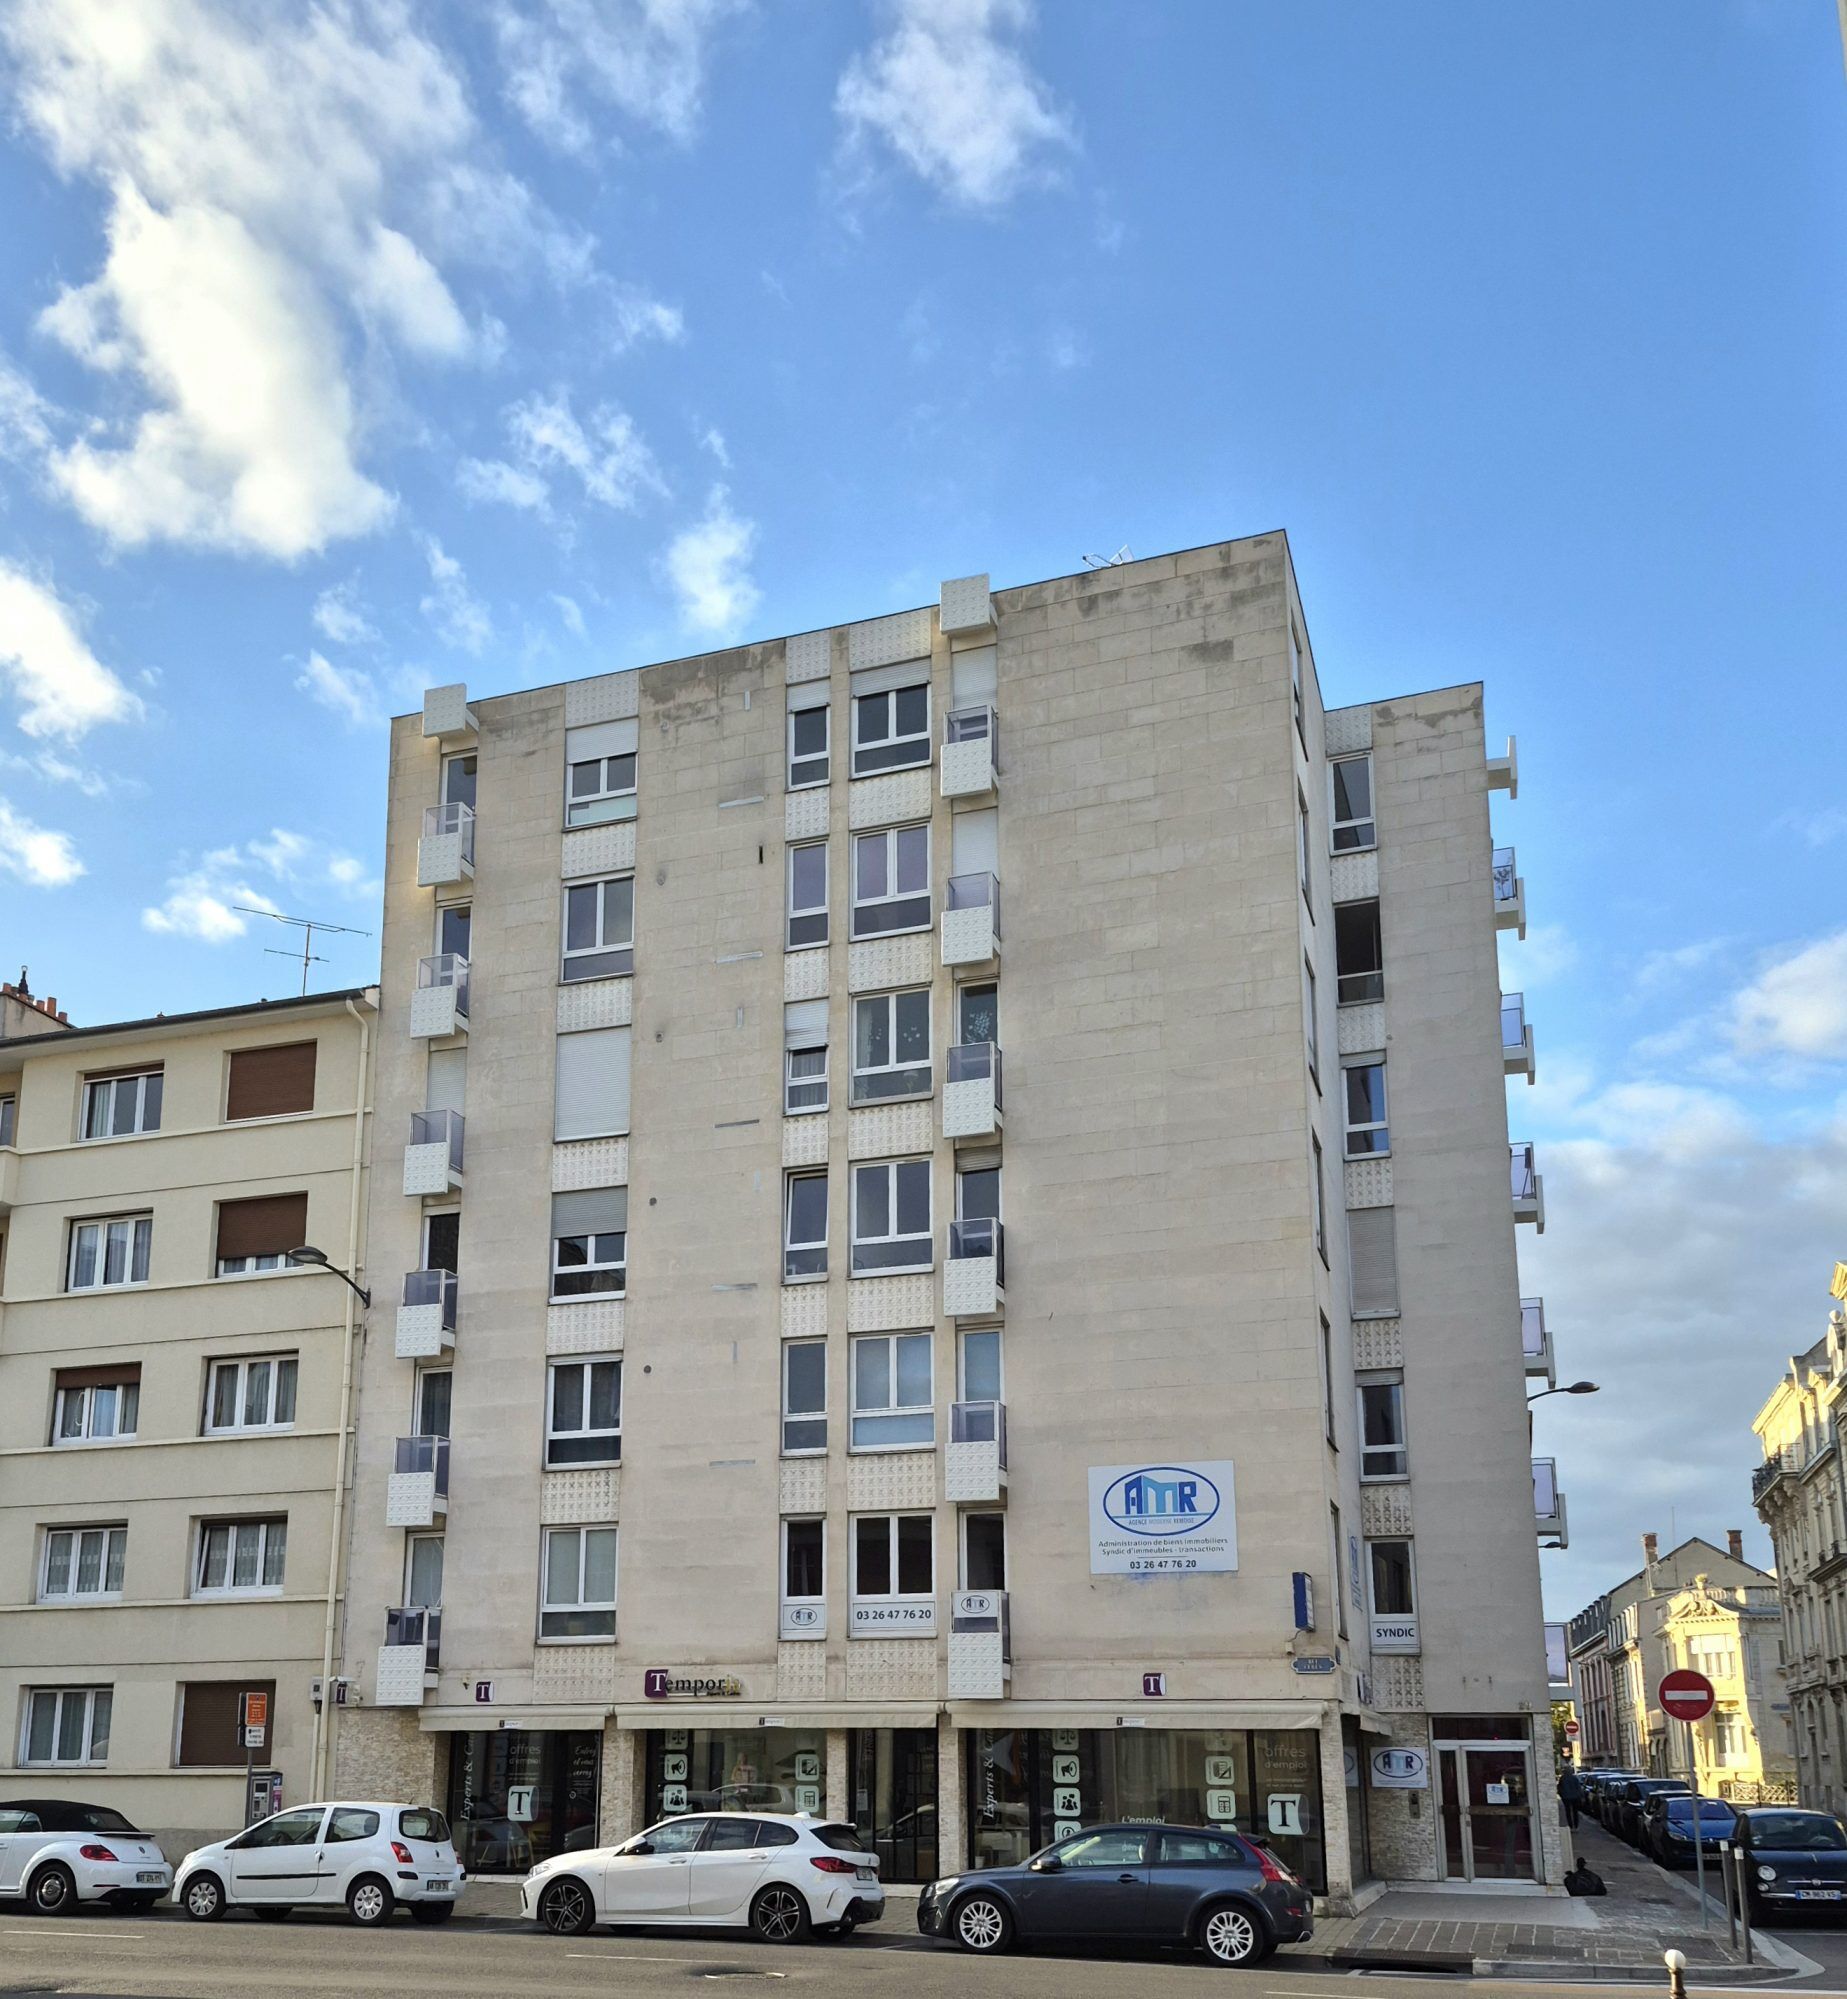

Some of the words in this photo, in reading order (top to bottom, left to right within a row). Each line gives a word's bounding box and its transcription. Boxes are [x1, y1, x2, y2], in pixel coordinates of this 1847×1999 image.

[1124, 1475, 1197, 1515] AMR
[1098, 1540, 1152, 1548] Administration
[1163, 1538, 1183, 1546] biens
[1184, 1537, 1228, 1545] immobiliers
[1102, 1547, 1125, 1556] Syndic
[1126, 1546, 1173, 1555] d'immeubles
[1179, 1545, 1225, 1553] transactions
[1129, 1561, 1141, 1570] 03
[1143, 1560, 1155, 1569] 26
[1157, 1560, 1168, 1568] 47
[1171, 1559, 1183, 1568] 76
[1185, 1559, 1197, 1568] 20
[856, 1609, 870, 1620] 03
[872, 1609, 885, 1620] 26
[887, 1609, 900, 1620] 47
[903, 1608, 916, 1620] 76
[918, 1608, 932, 1619] 20
[1376, 1627, 1415, 1638] SYNDIC
[1144, 1676, 1159, 1693] T
[477, 1684, 489, 1699] T
[510, 1744, 541, 1755] offres
[1264, 1744, 1306, 1758] offres
[464, 1760, 473, 1772] &
[983, 1757, 994, 1769] &
[1264, 1760, 1307, 1770] d'emploi
[460, 1776, 474, 1820] Experts
[983, 1772, 998, 1819] Experts
[510, 1791, 530, 1815] T
[1270, 1799, 1296, 1828] T
[1122, 1815, 1166, 1825] L'emploi
